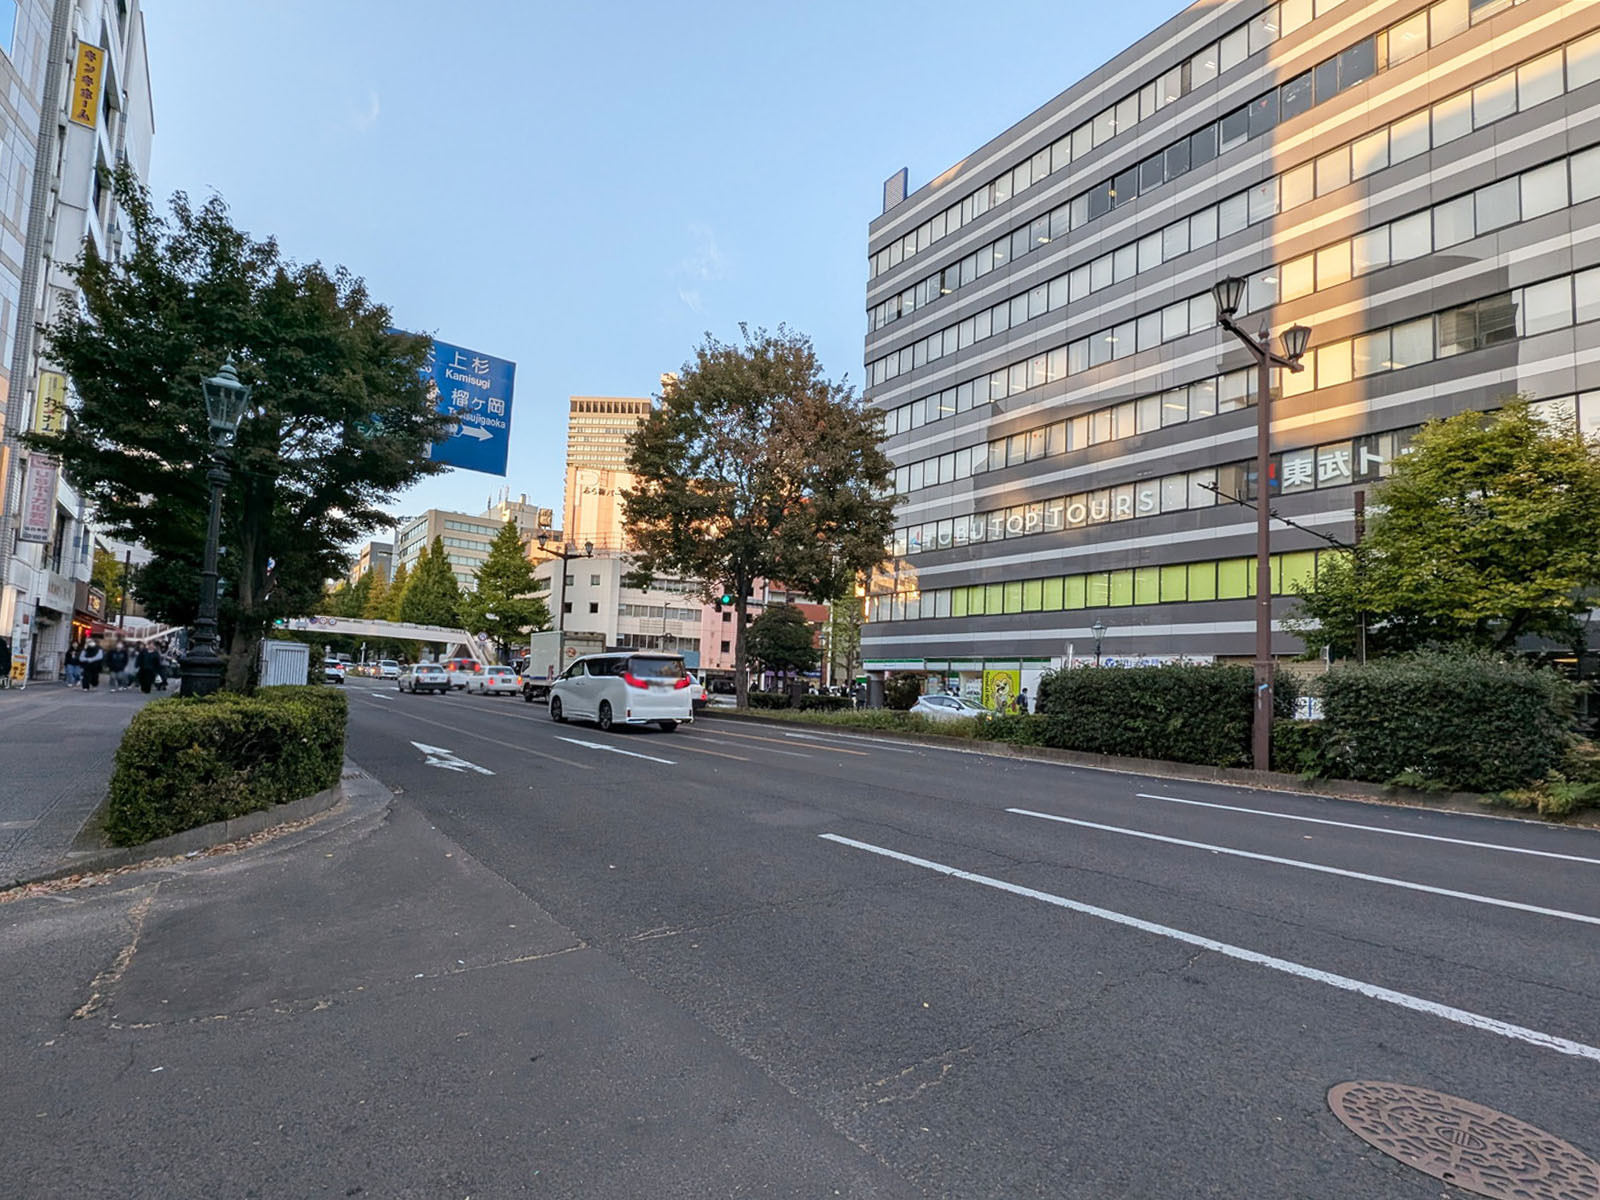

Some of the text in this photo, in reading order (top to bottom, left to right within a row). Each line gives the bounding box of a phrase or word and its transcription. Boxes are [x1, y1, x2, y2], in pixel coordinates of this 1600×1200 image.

[448, 351, 490, 374] 上杉
[445, 368, 491, 390] Kamisugi
[991, 512, 1038, 537] TOP
[1050, 490, 1154, 528] TOURS
